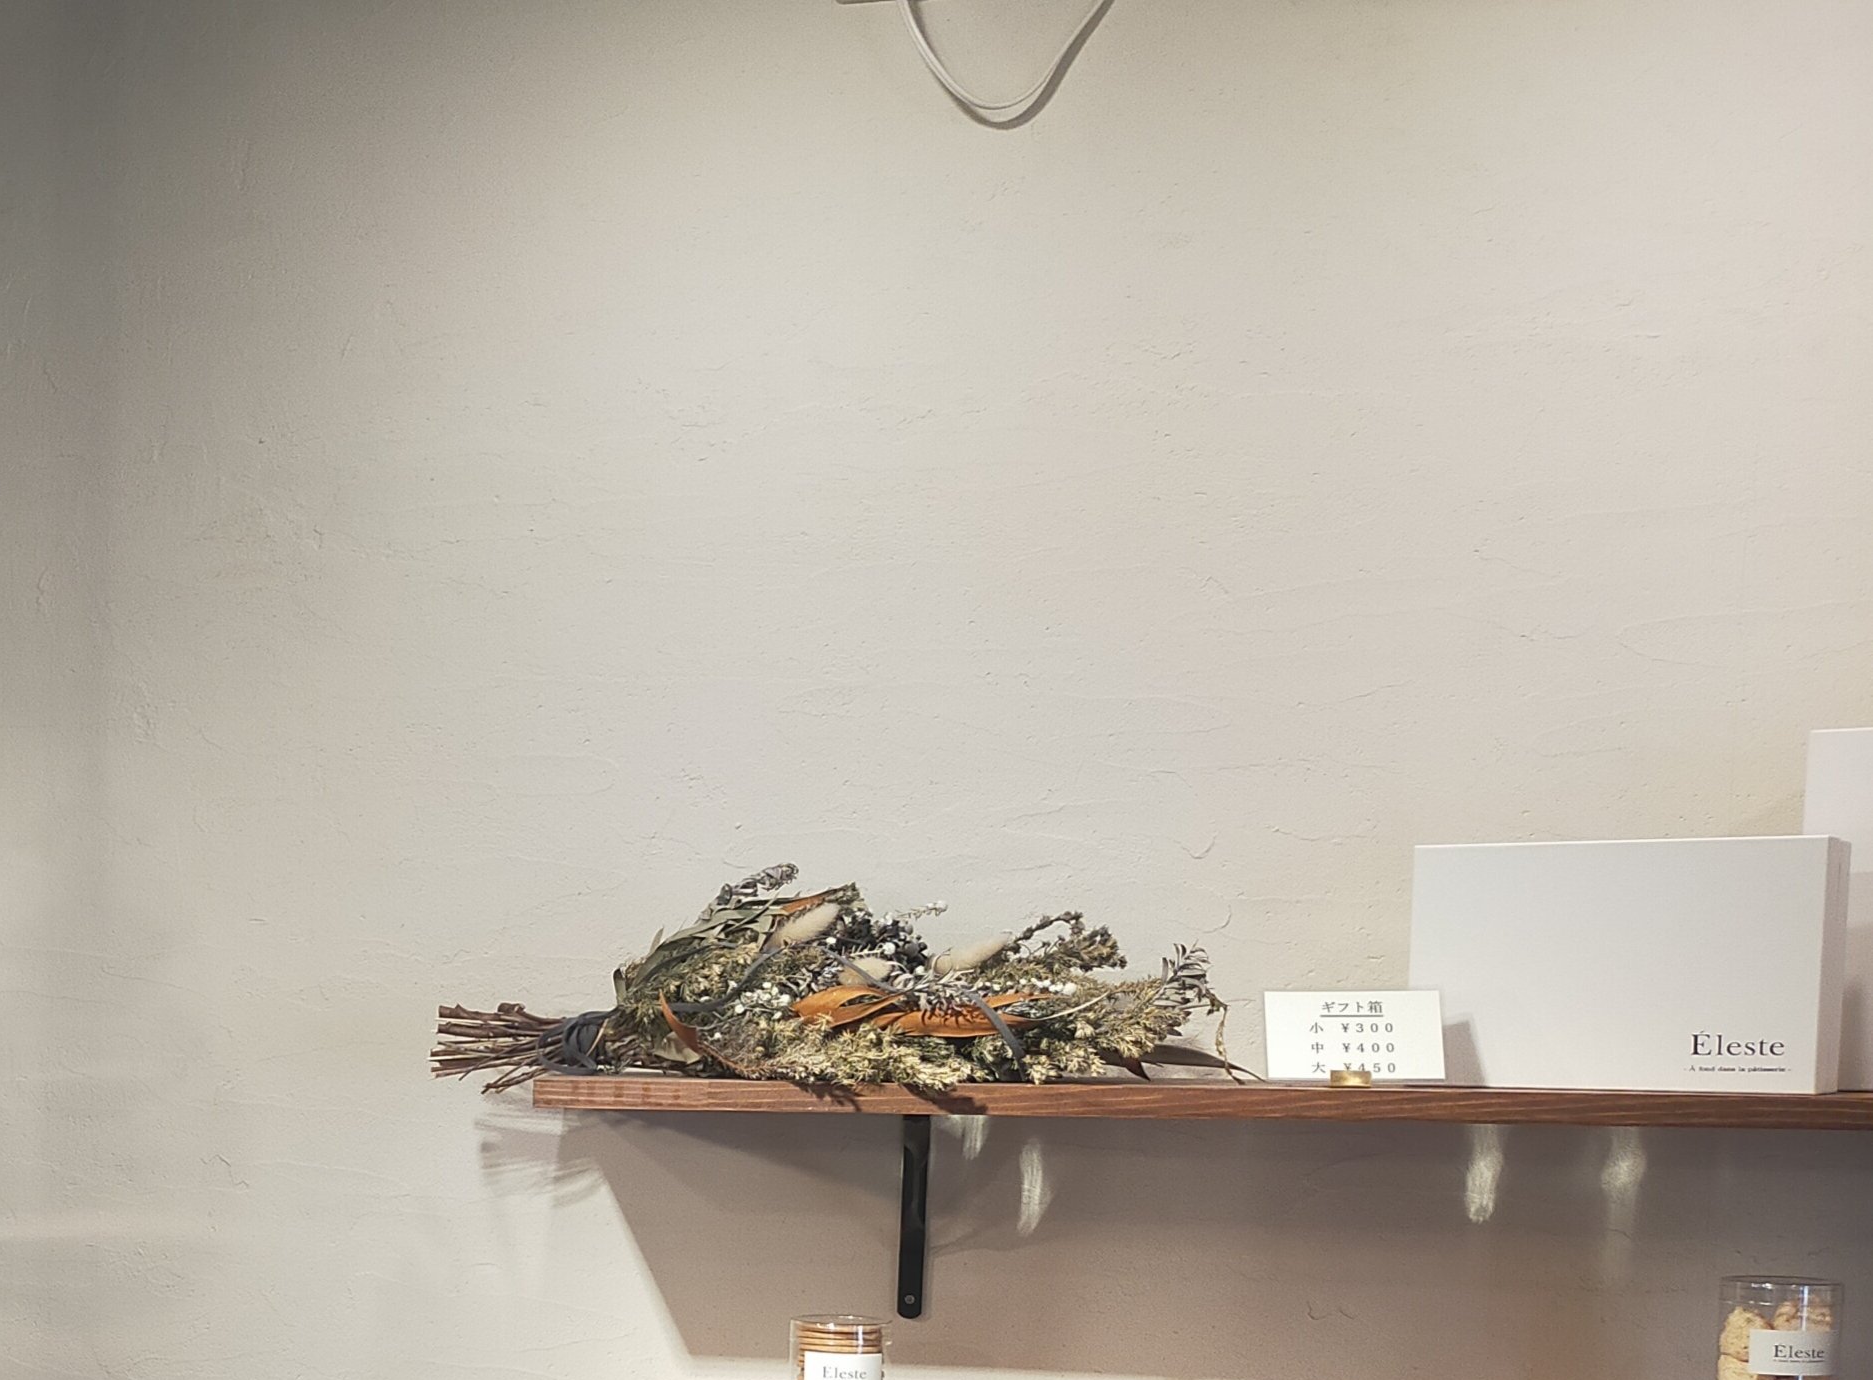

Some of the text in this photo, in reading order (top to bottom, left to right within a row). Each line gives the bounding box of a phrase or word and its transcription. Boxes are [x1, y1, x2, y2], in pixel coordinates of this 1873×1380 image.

[1321, 1000, 1383, 1014] ギフト箱
[1309, 1022, 1324, 1034] 小
[1311, 1042, 1325, 1054] 中
[1690, 1030, 1786, 1056] Éleste
[1312, 1062, 1326, 1074] 大
